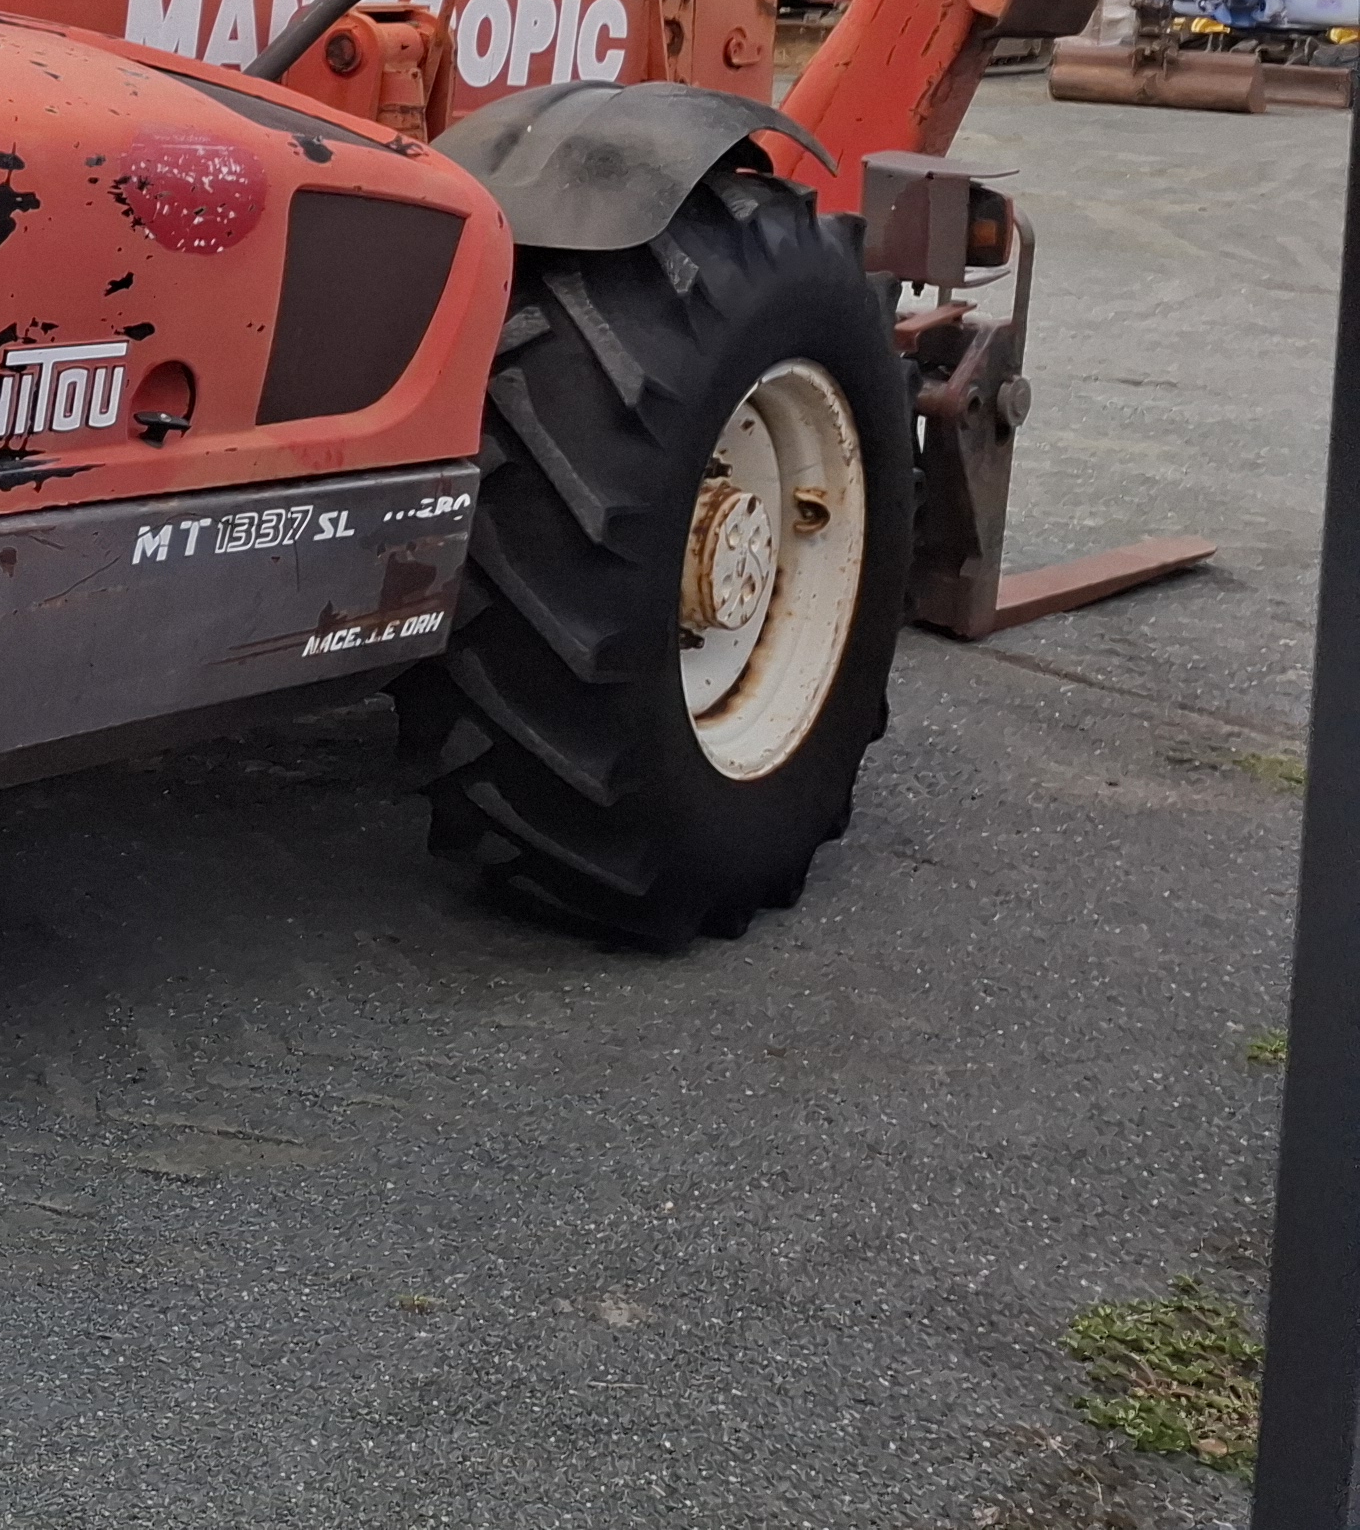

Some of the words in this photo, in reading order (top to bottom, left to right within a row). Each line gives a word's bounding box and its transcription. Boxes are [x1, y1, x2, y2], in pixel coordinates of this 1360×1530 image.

[132, 518, 211, 565] MT
[214, 504, 314, 554] 1337
[313, 510, 355, 541] SL
